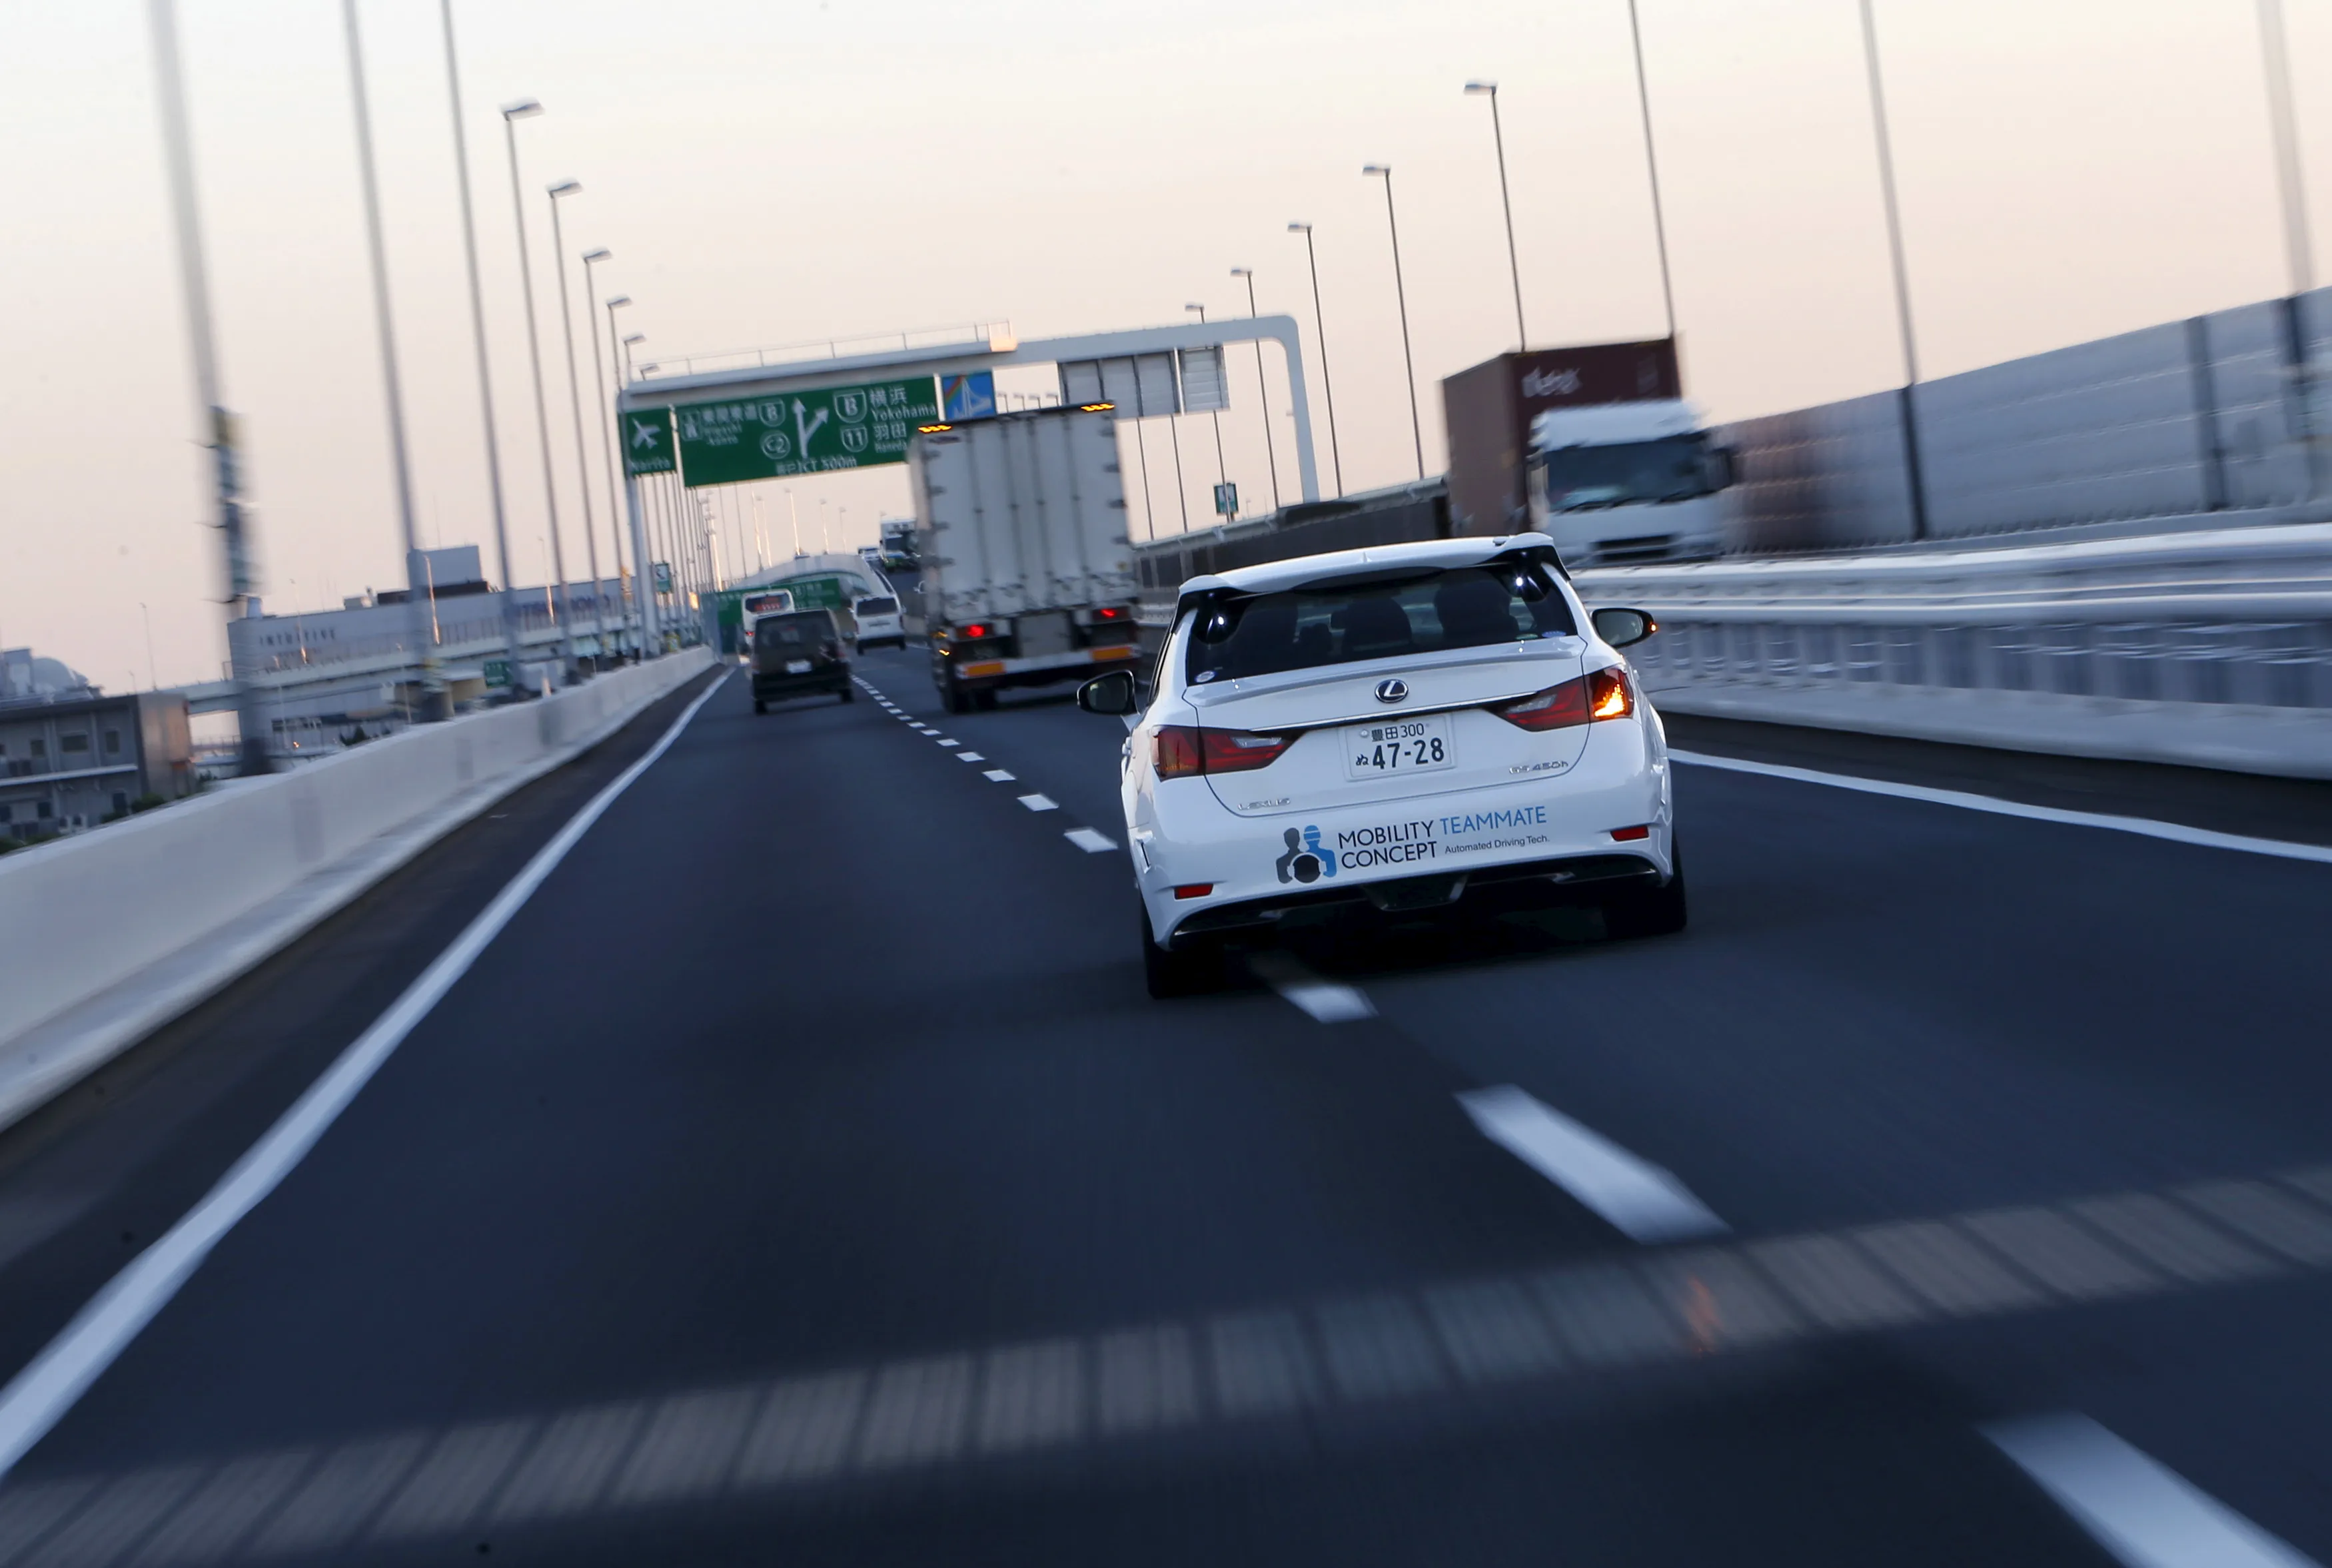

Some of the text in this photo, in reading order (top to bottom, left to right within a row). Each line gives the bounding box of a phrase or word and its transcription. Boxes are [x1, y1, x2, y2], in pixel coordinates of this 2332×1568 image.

[869, 386, 907, 408] 横浜
[871, 403, 937, 422] Yokohama
[873, 420, 907, 441] 羽田
[1401, 723, 1425, 738] 300
[1373, 737, 1445, 769] 47-28
[1237, 798, 1290, 810] LEXUS
[1338, 806, 1546, 849] MOBILITY TEAMMATE
[1445, 834, 1550, 854] Automated Driving Tech.
[1341, 841, 1437, 869] CONCEPT
